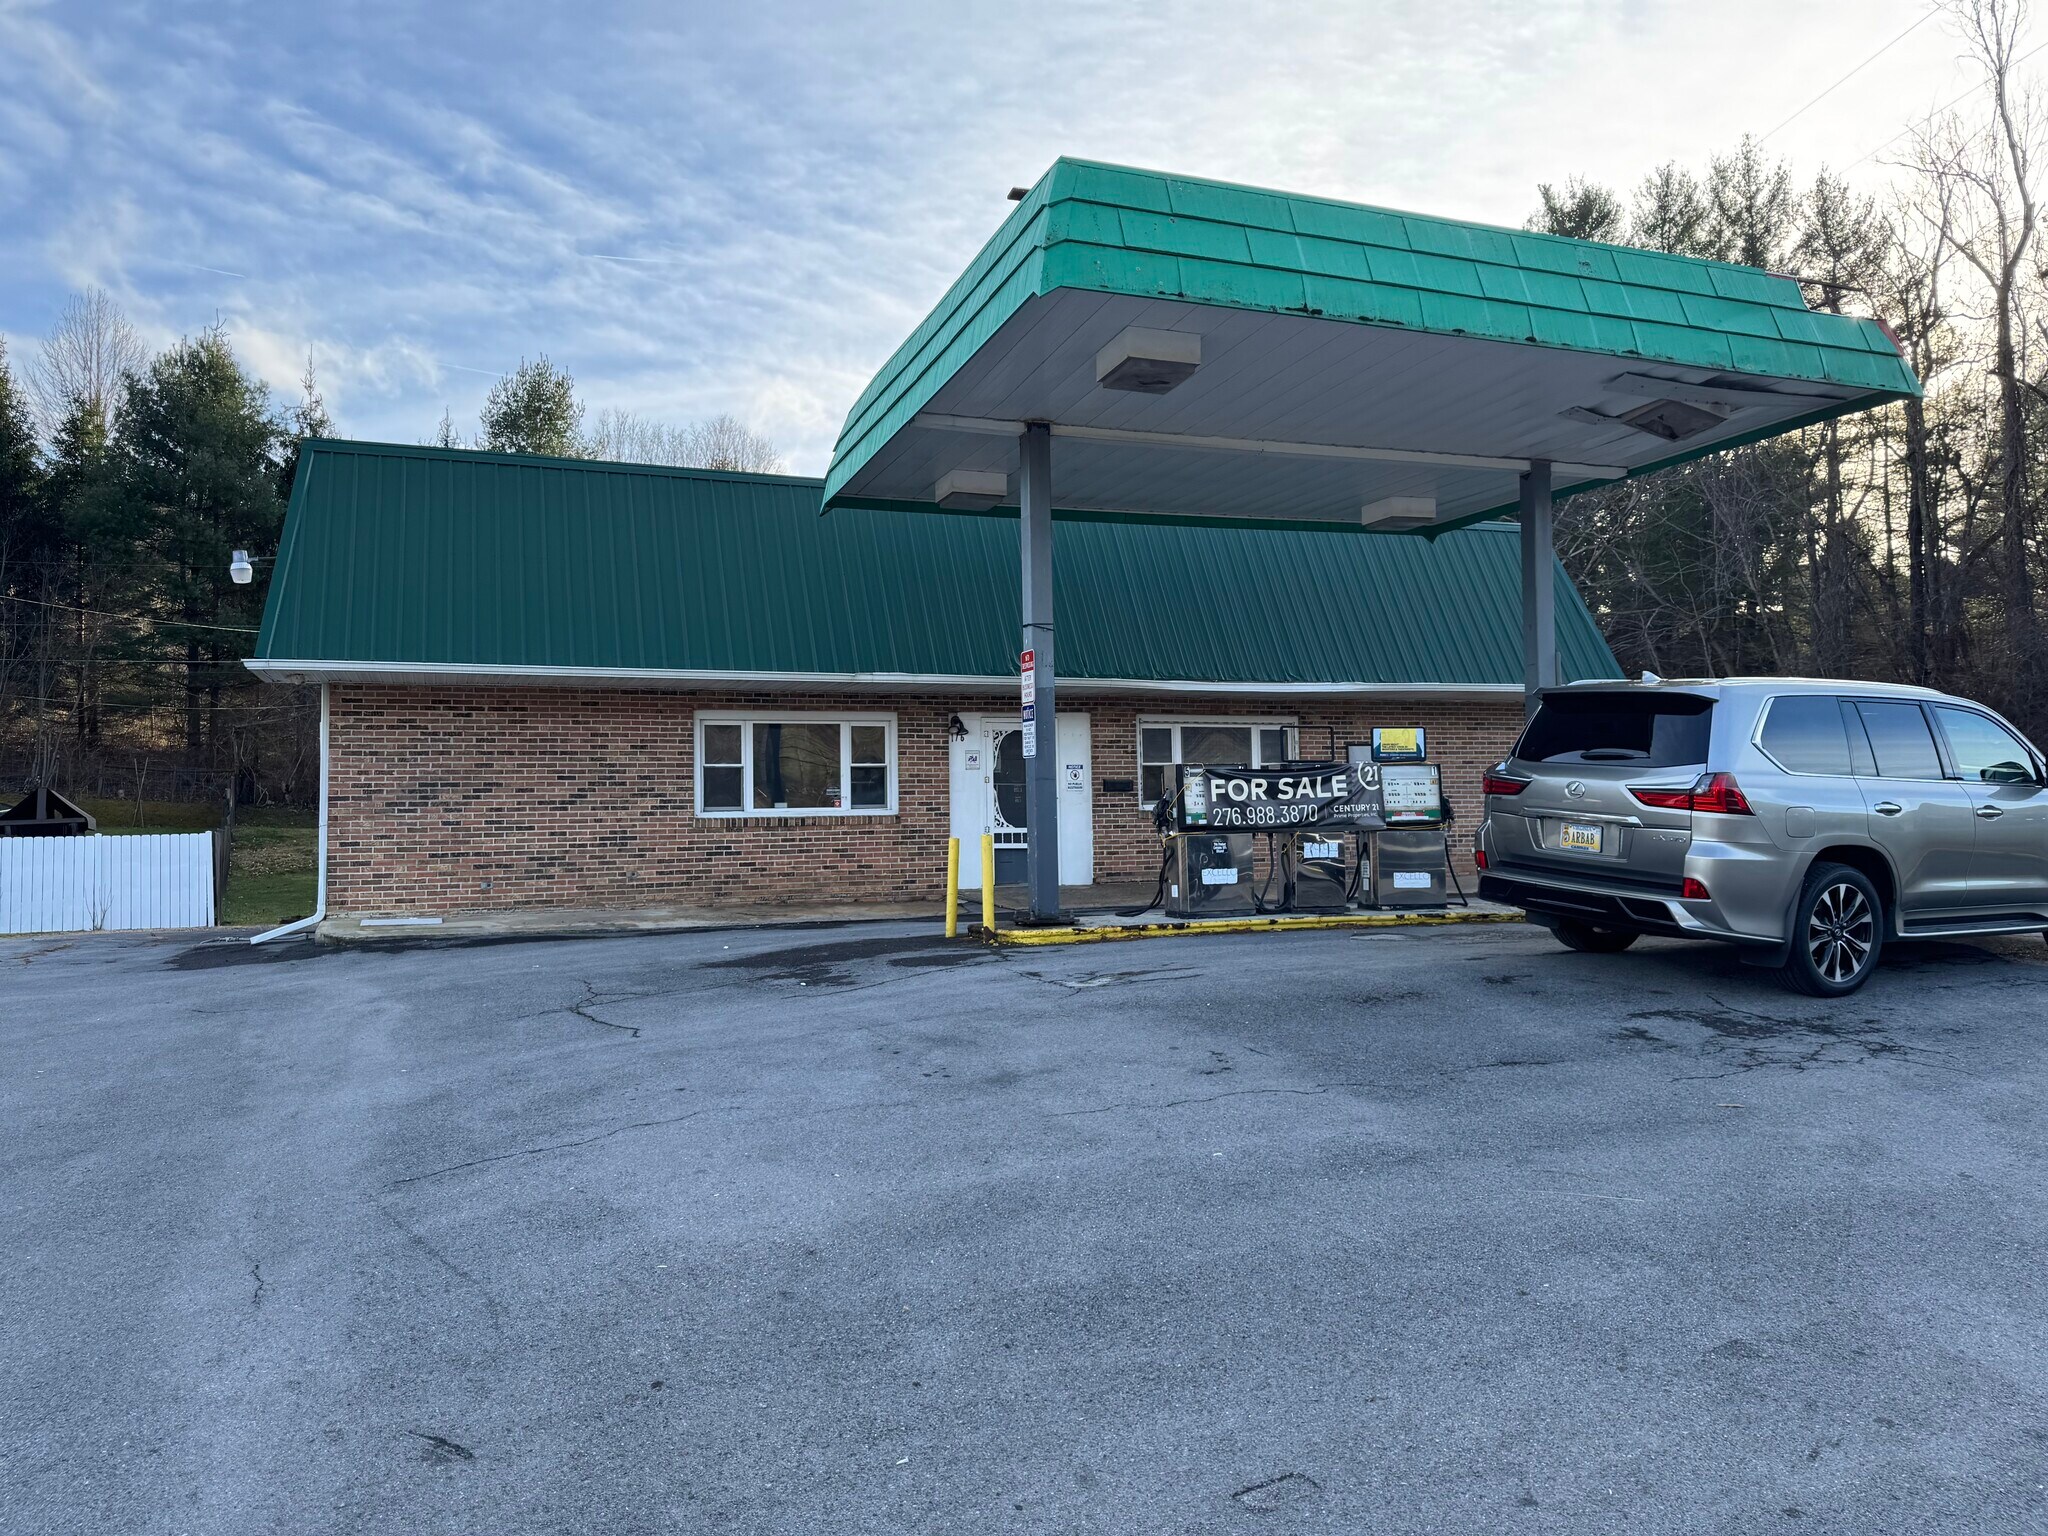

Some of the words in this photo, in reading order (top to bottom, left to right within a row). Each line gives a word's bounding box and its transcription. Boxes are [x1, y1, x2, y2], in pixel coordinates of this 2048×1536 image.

[1210, 778, 1268, 802] FOR
[1277, 774, 1348, 801] SALE
[1213, 804, 1318, 826] 276.988.3870
[1333, 803, 1371, 813] CENTURY
[1372, 803, 1380, 811] 21
[1571, 831, 1595, 845] ARBAB
